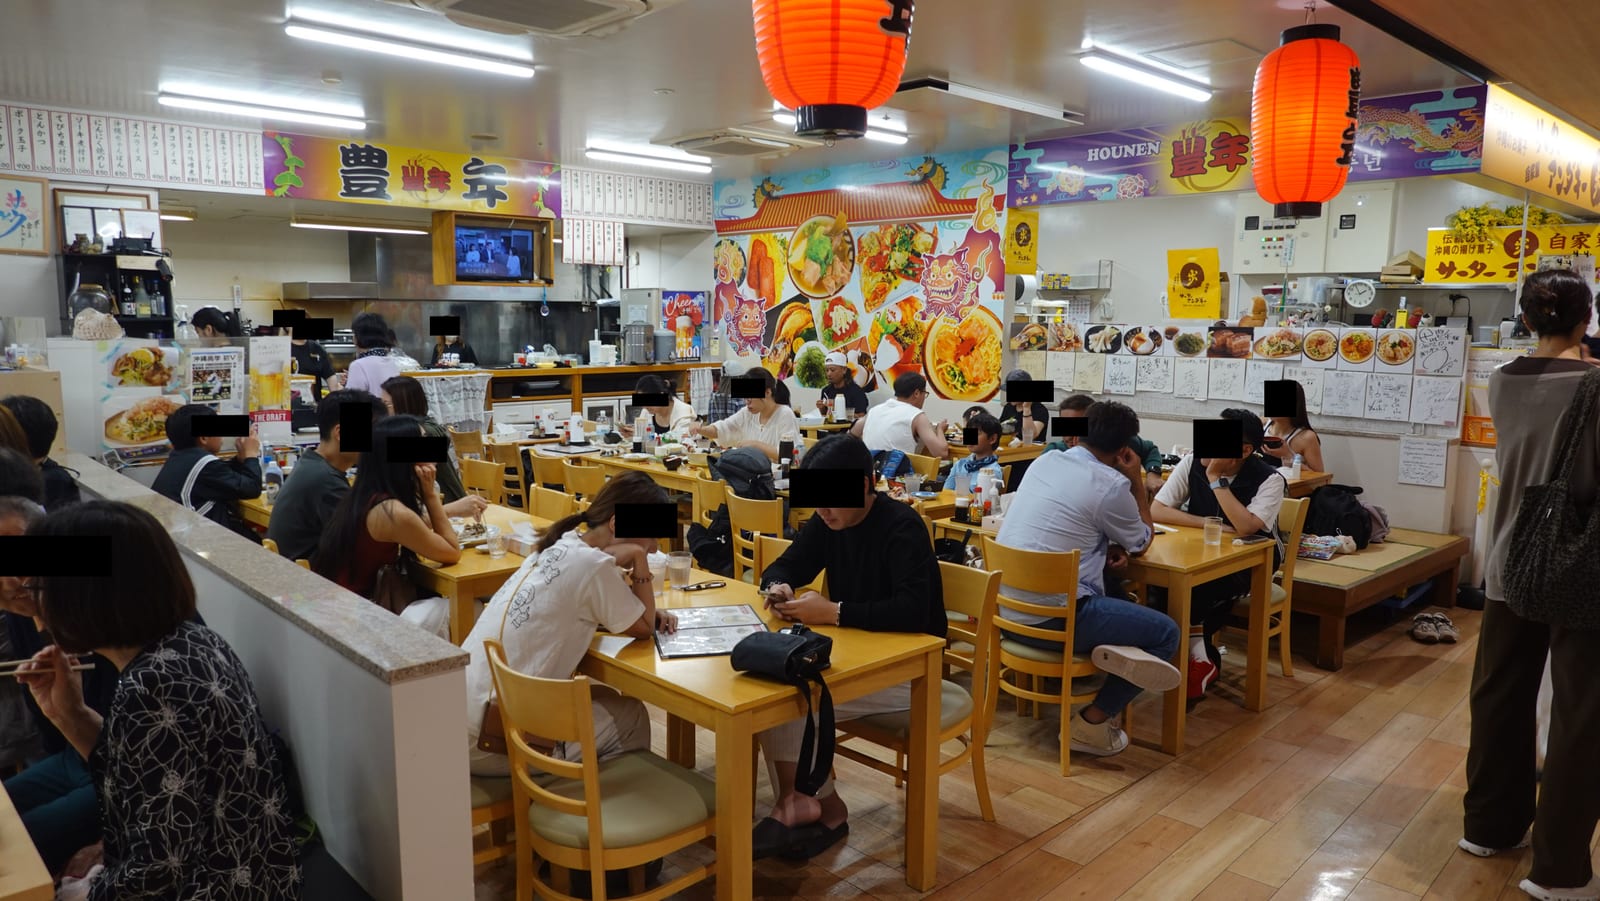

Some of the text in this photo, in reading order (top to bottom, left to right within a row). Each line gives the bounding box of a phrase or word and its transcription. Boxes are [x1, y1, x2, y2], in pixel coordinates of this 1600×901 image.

[36, 112, 47, 145] とんかつ
[132, 122, 143, 163] オムライス
[168, 126, 178, 166] タコライス
[1087, 141, 1162, 161] HOUNEN
[1170, 129, 1249, 178] 豊年
[339, 143, 392, 201] 豊
[462, 157, 508, 208] 年
[1436, 260, 1497, 279] サーター
[253, 413, 287, 422] THE DRAFT
